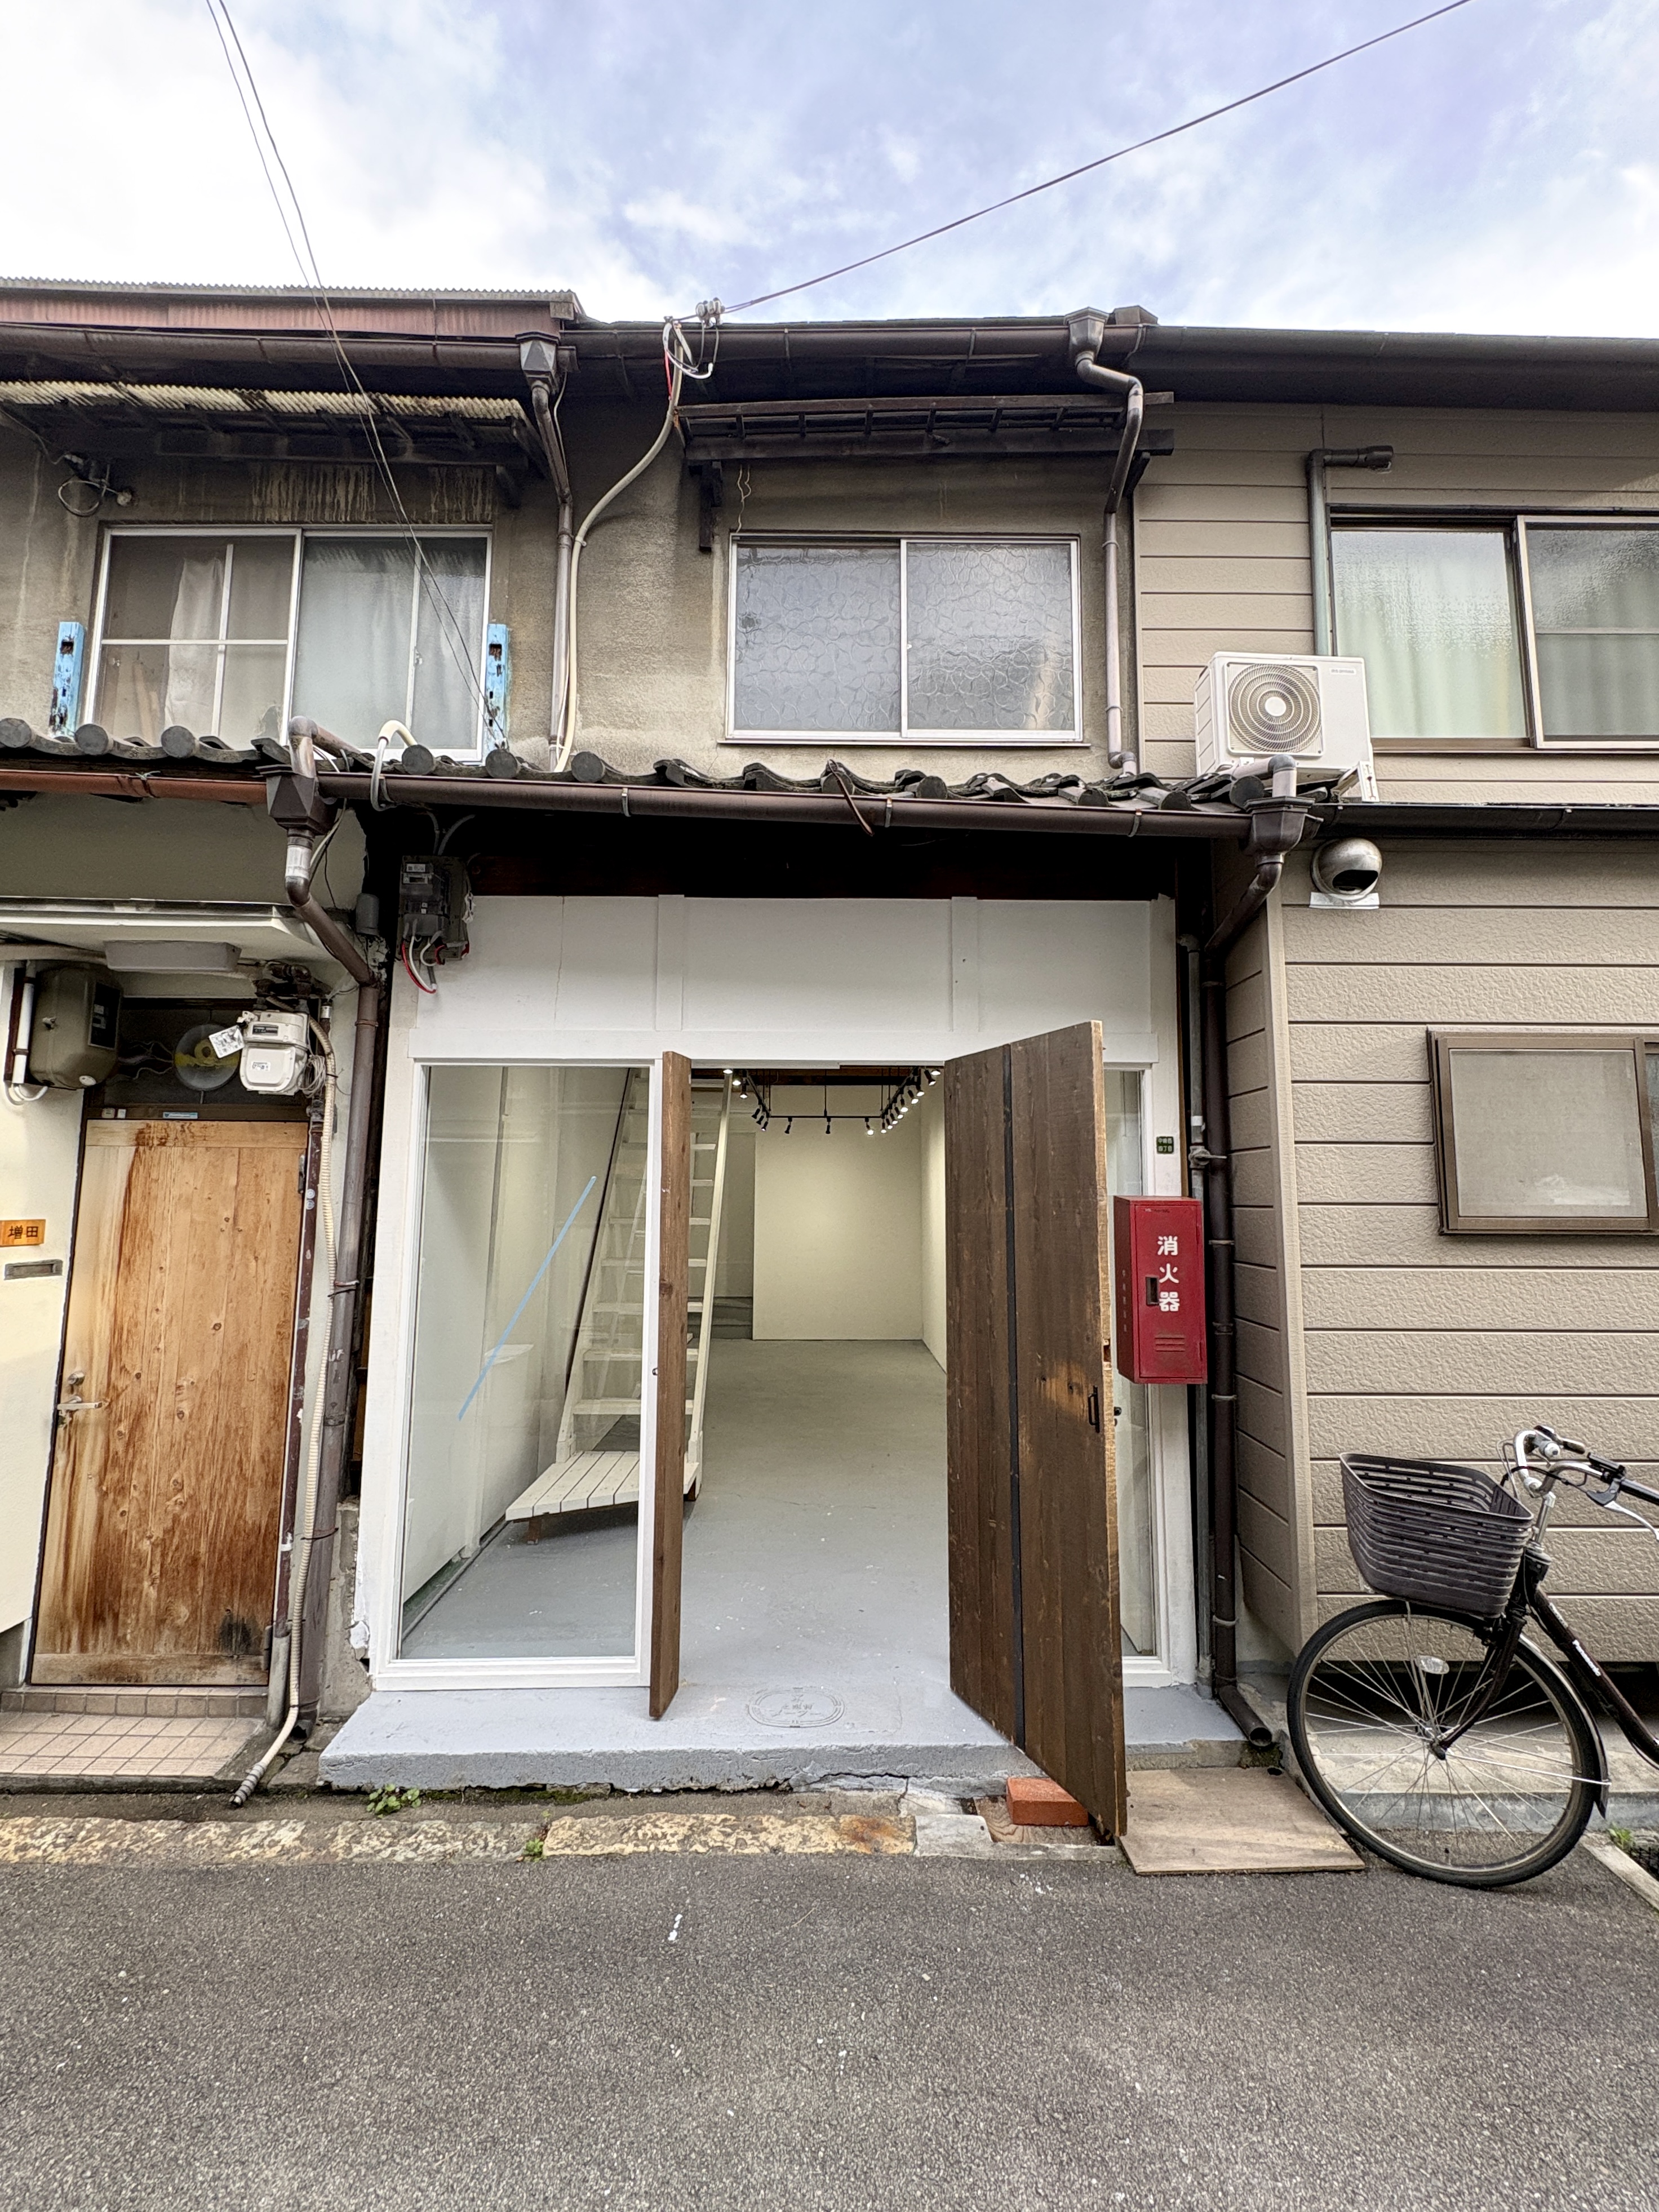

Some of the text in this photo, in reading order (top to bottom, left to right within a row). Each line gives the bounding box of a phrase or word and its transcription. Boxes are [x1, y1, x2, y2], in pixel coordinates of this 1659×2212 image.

[7, 1225, 38, 1239] 増田
[1157, 1235, 1180, 1312] 消火器
[1572, 1639, 1602, 1677] Panasonic
